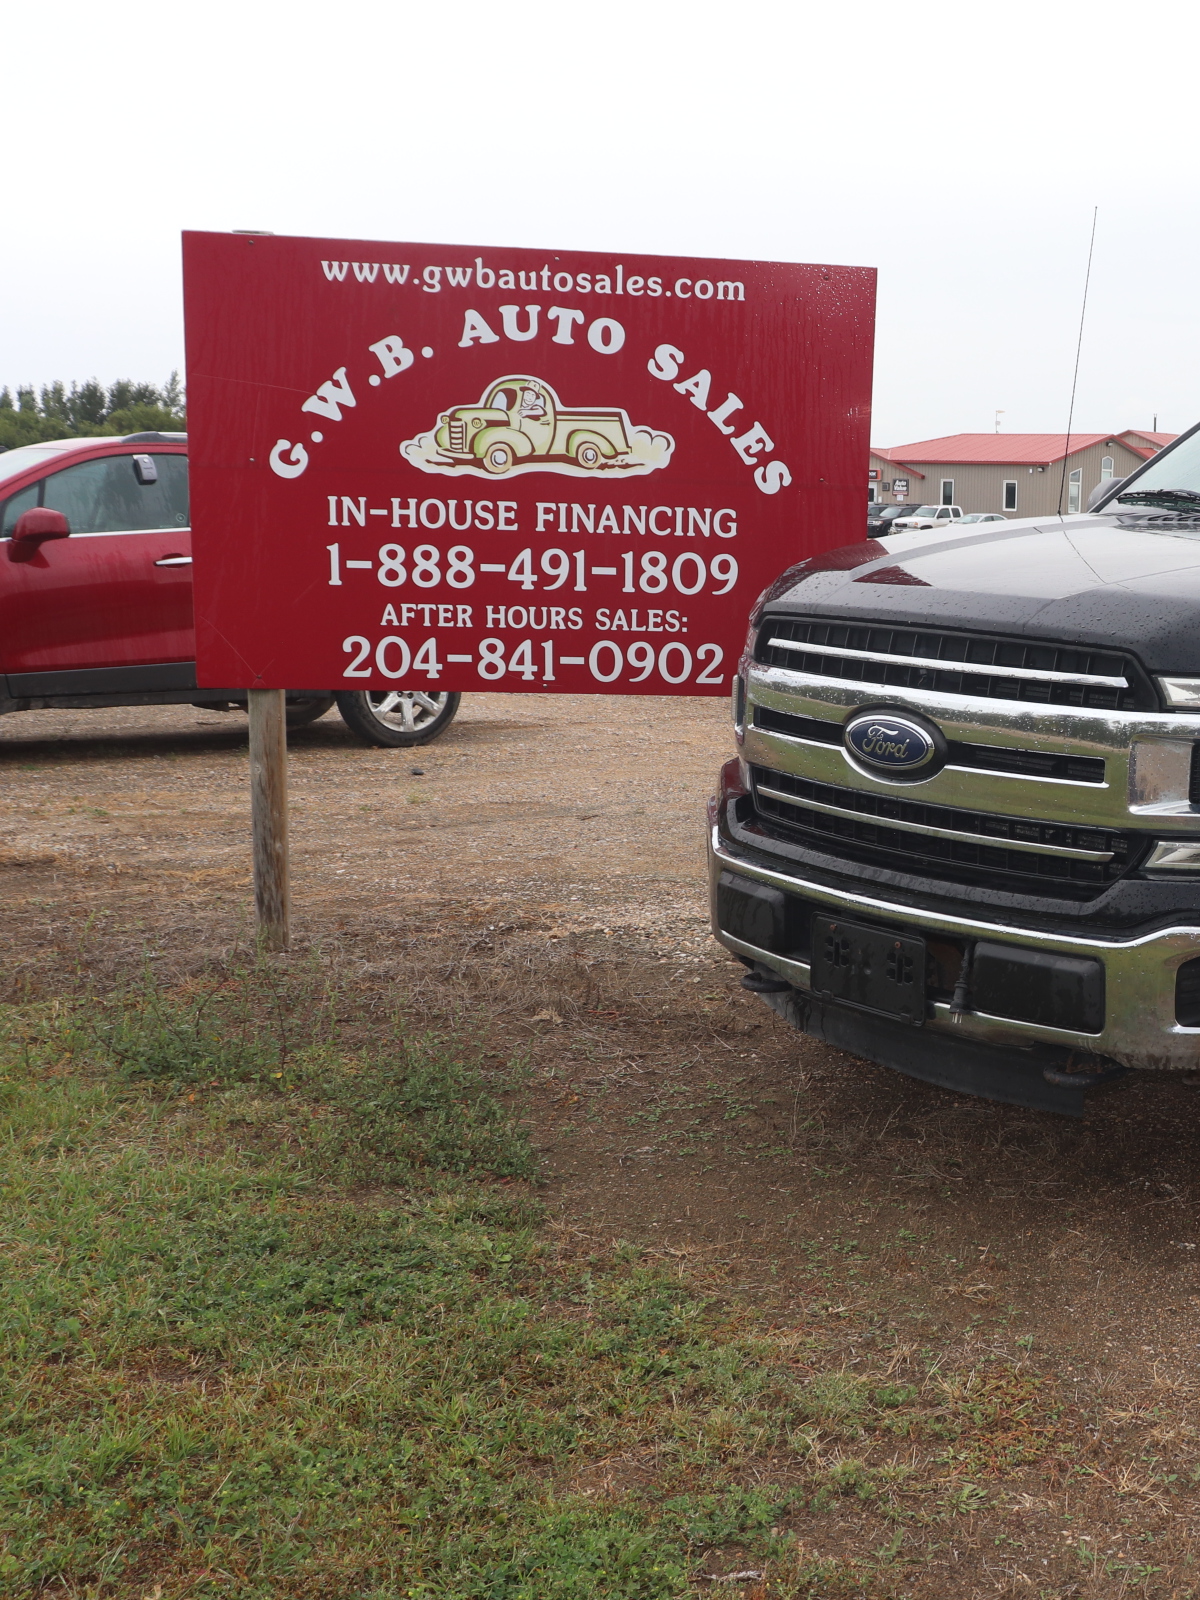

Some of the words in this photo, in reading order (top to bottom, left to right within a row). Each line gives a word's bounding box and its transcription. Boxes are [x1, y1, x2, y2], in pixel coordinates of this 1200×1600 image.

[320, 257, 746, 301] www.gwbautosales.com
[458, 305, 626, 355] AUTO
[648, 343, 793, 495] SALES
[327, 496, 519, 531] IN-HOUSE
[535, 503, 738, 538] FINANCING
[327, 542, 739, 595] 1-888-491-1809
[380, 603, 473, 628] AFTER
[485, 605, 583, 630] HOURS
[595, 608, 689, 633] SALES:
[342, 635, 724, 684] 204-841-0902
[862, 724, 910, 759] Ford
